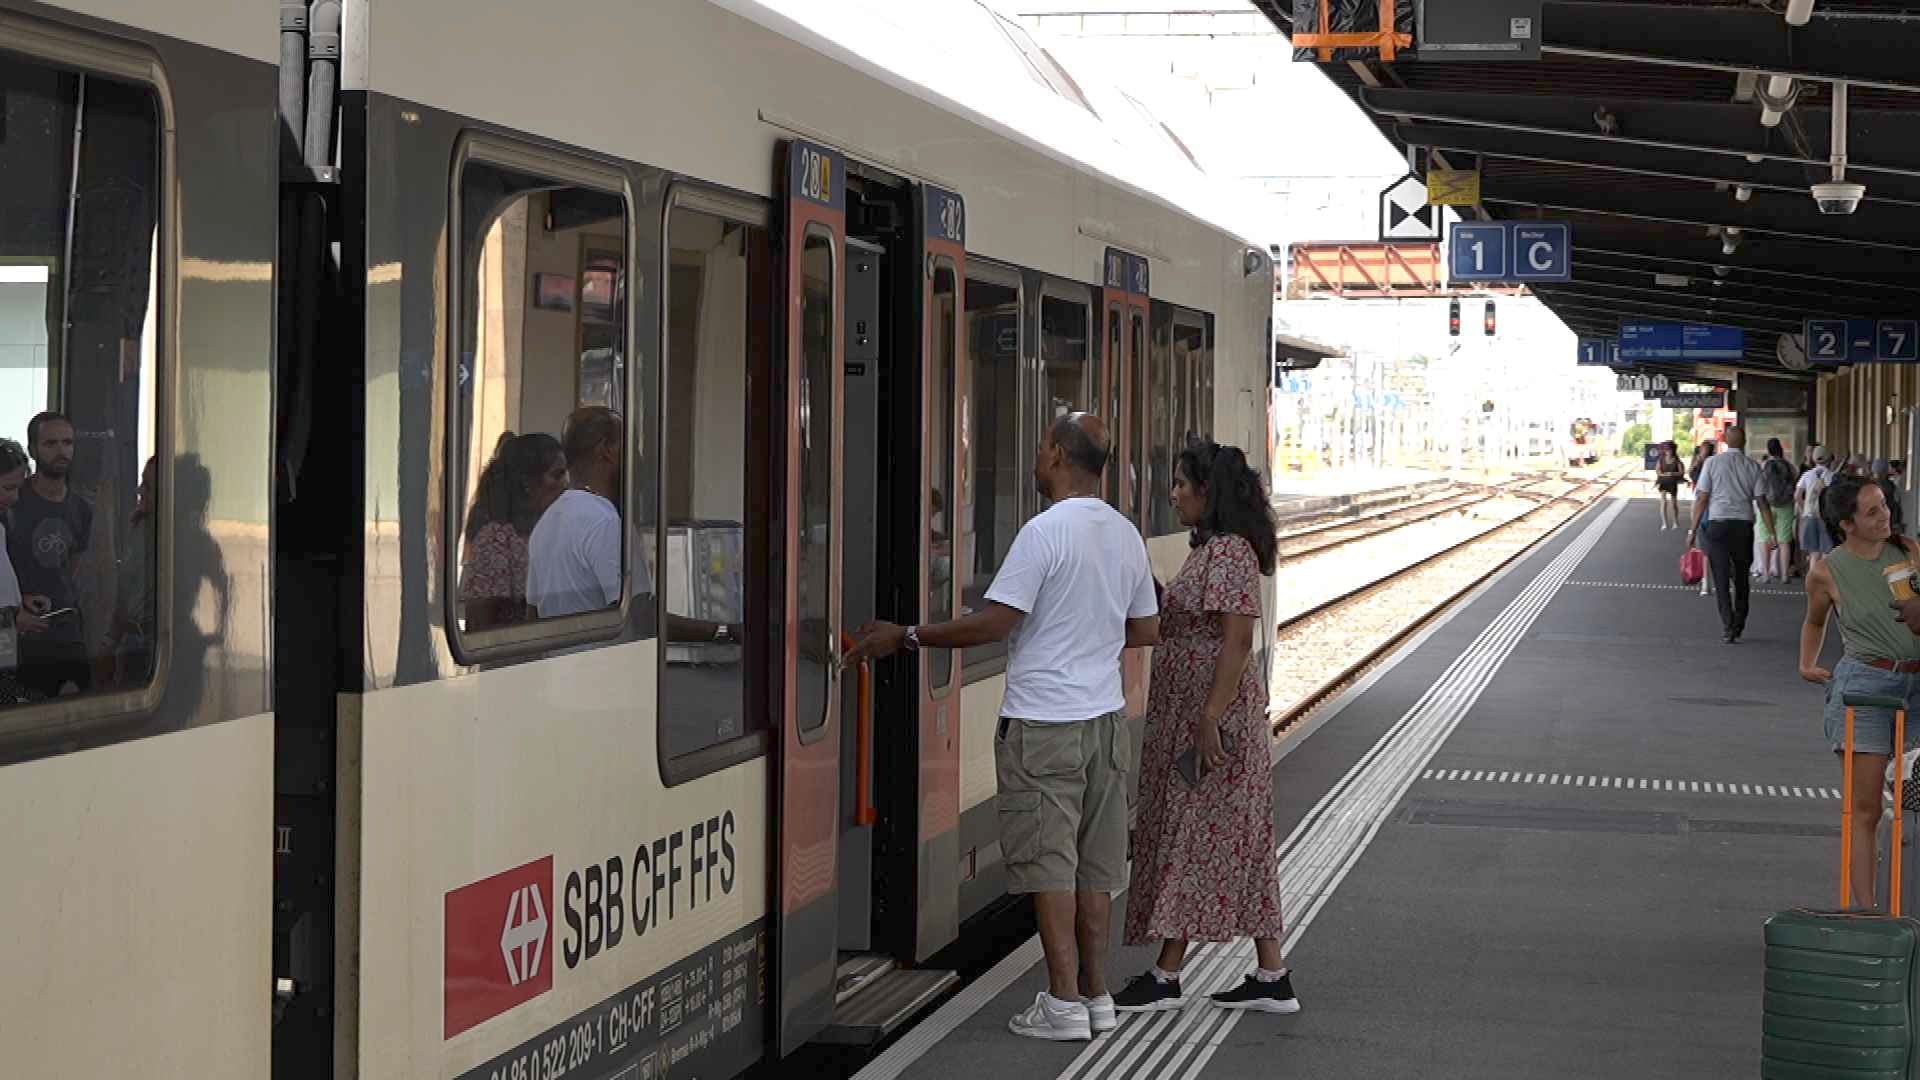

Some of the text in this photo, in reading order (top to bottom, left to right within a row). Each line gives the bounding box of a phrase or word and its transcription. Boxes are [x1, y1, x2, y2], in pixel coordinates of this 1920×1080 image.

[801, 147, 810, 197] 2
[1471, 241, 1553, 271] 1 C
[1586, 346, 1594, 361] 1
[1818, 333, 1836, 355] 2
[1888, 333, 1905, 355] 7
[563, 809, 735, 969] SBB CFF FFS
[542, 1035, 567, 1080] 522
[569, 1015, 603, 1071] 209-1
[610, 985, 656, 1048] CH-CFF
